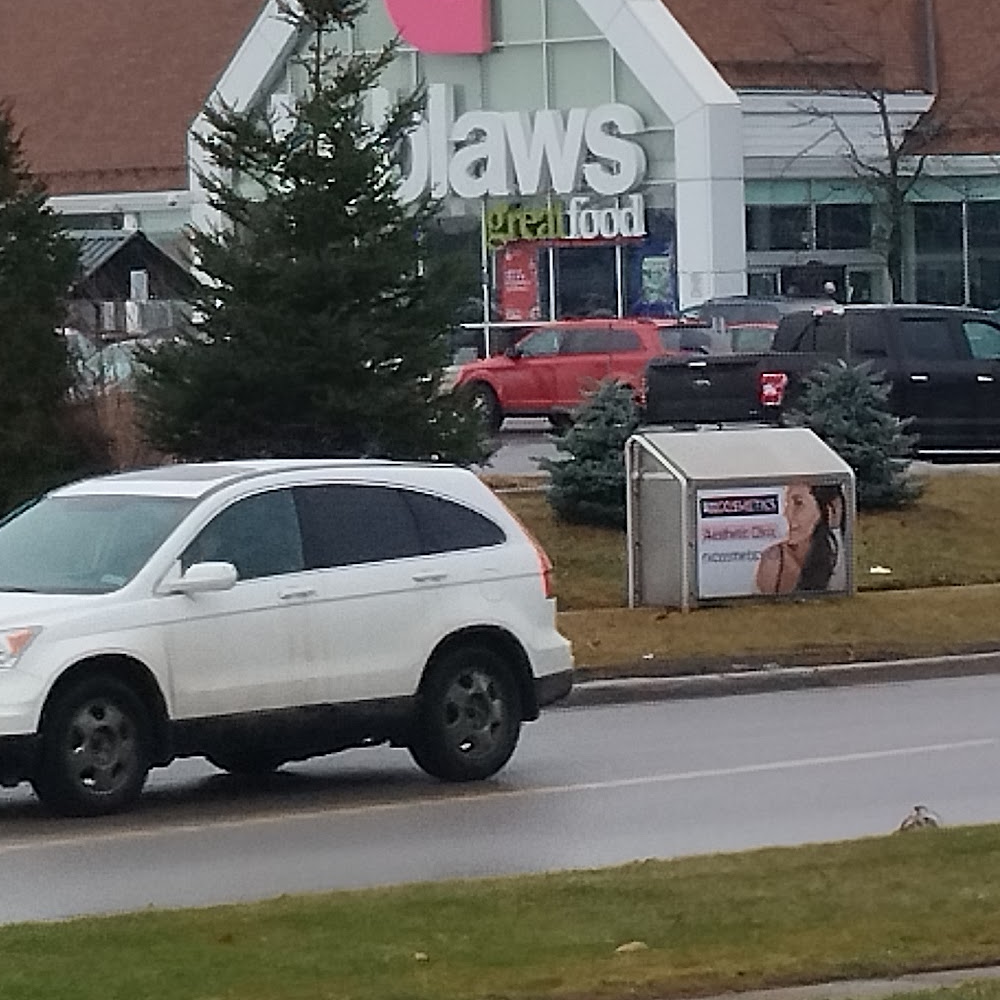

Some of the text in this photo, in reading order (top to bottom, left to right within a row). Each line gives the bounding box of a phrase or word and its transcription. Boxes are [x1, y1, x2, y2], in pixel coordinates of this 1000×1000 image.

[270, 83, 648, 200] olaws
[487, 193, 647, 249] great food
